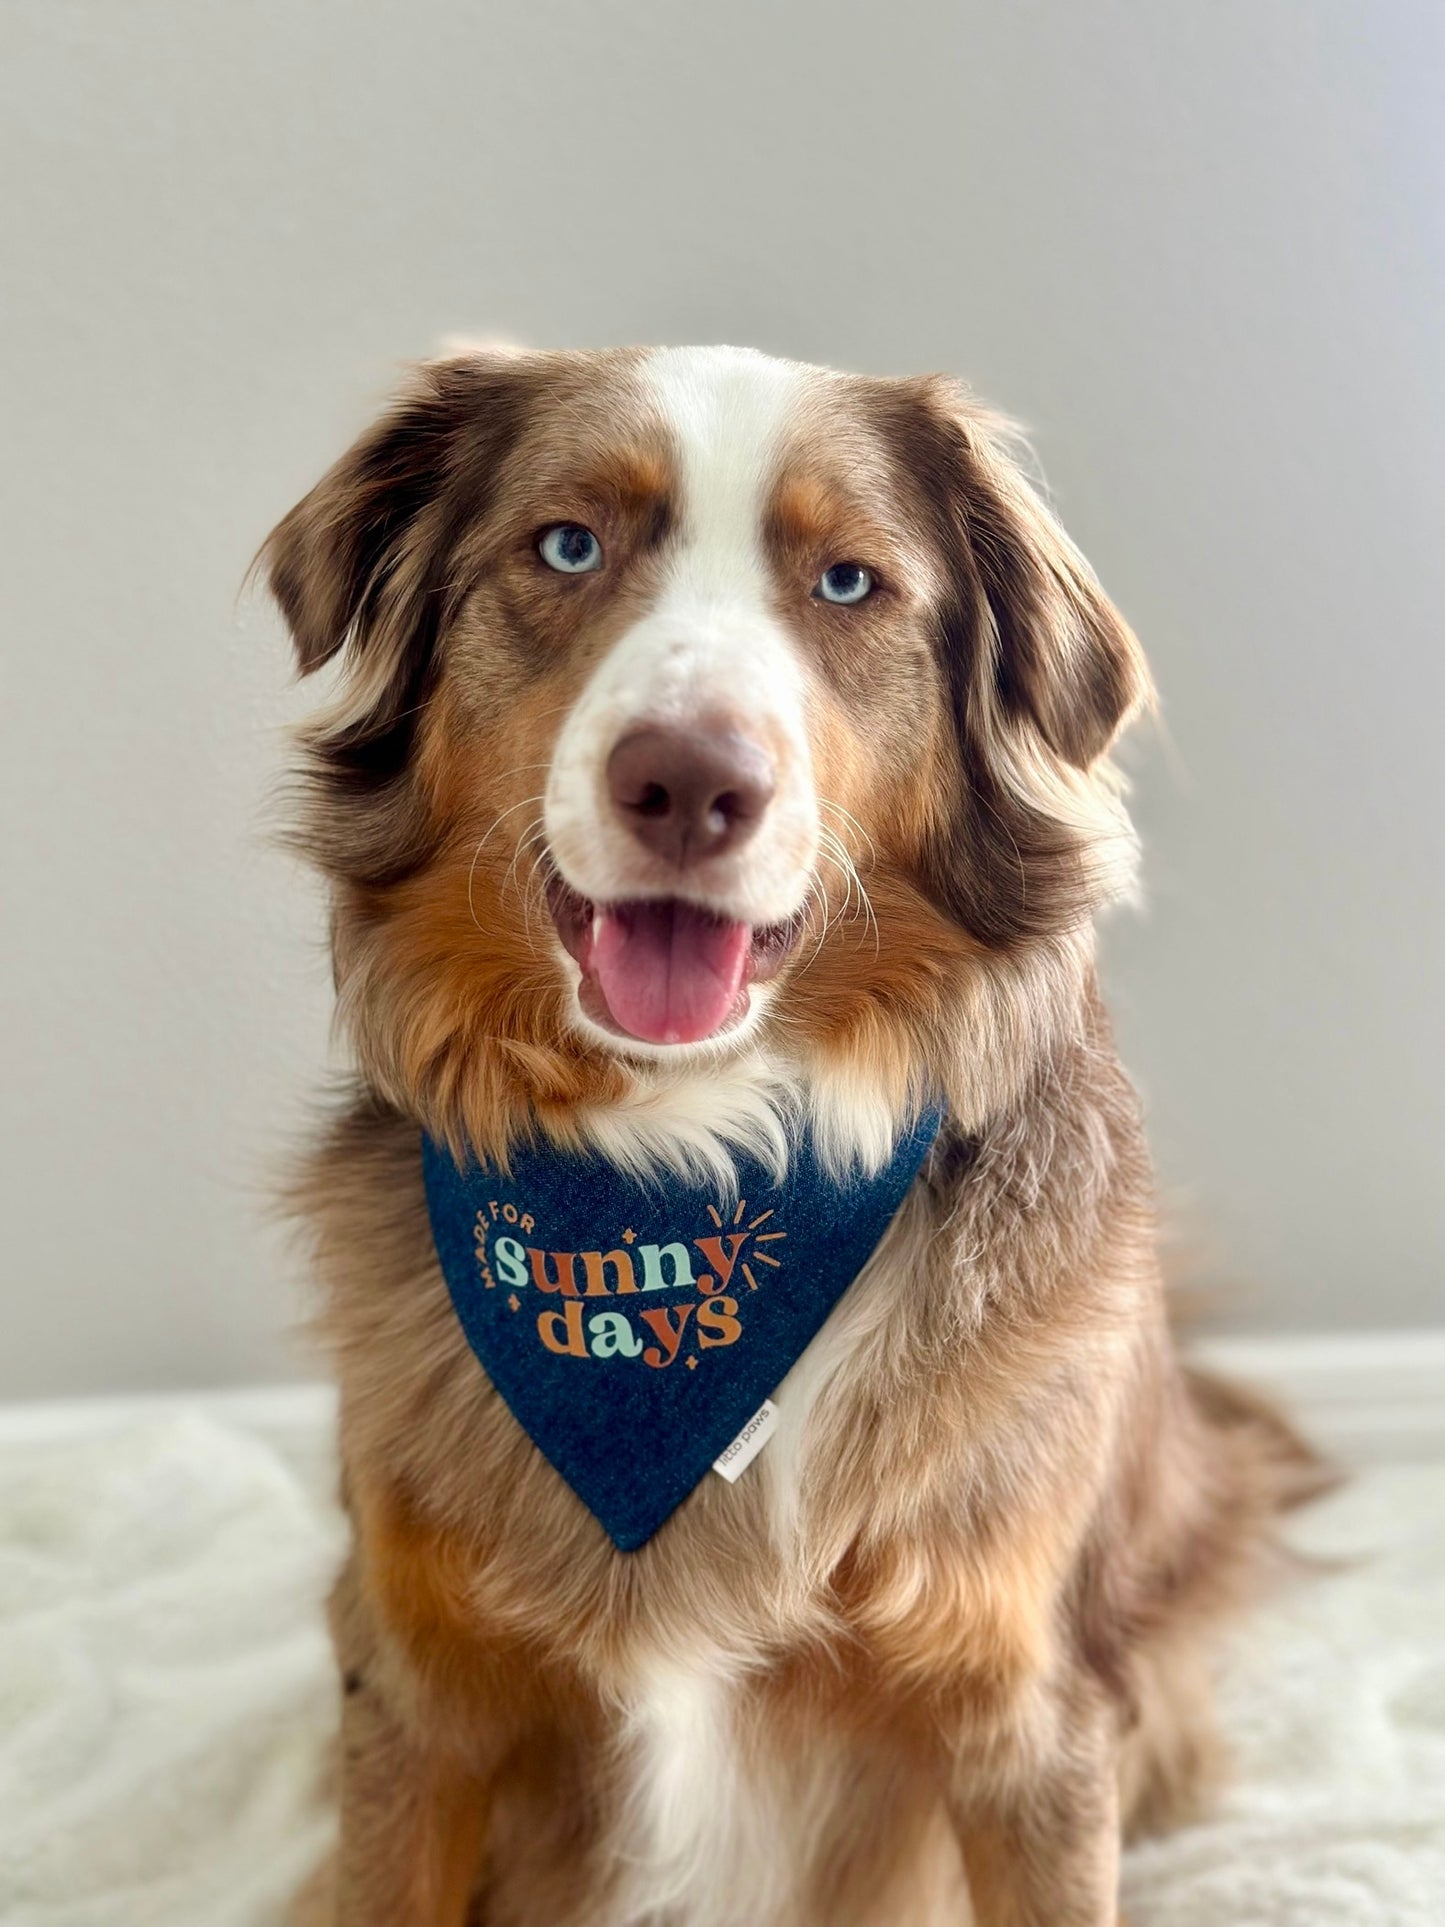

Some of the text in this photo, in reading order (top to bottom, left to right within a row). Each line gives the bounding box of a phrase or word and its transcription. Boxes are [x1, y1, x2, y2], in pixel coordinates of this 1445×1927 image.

[473, 1200, 535, 1288] MADE FOR
[494, 1232, 751, 1296] sunny
[536, 1295, 743, 1369] days
[741, 1408, 770, 1443] paws
